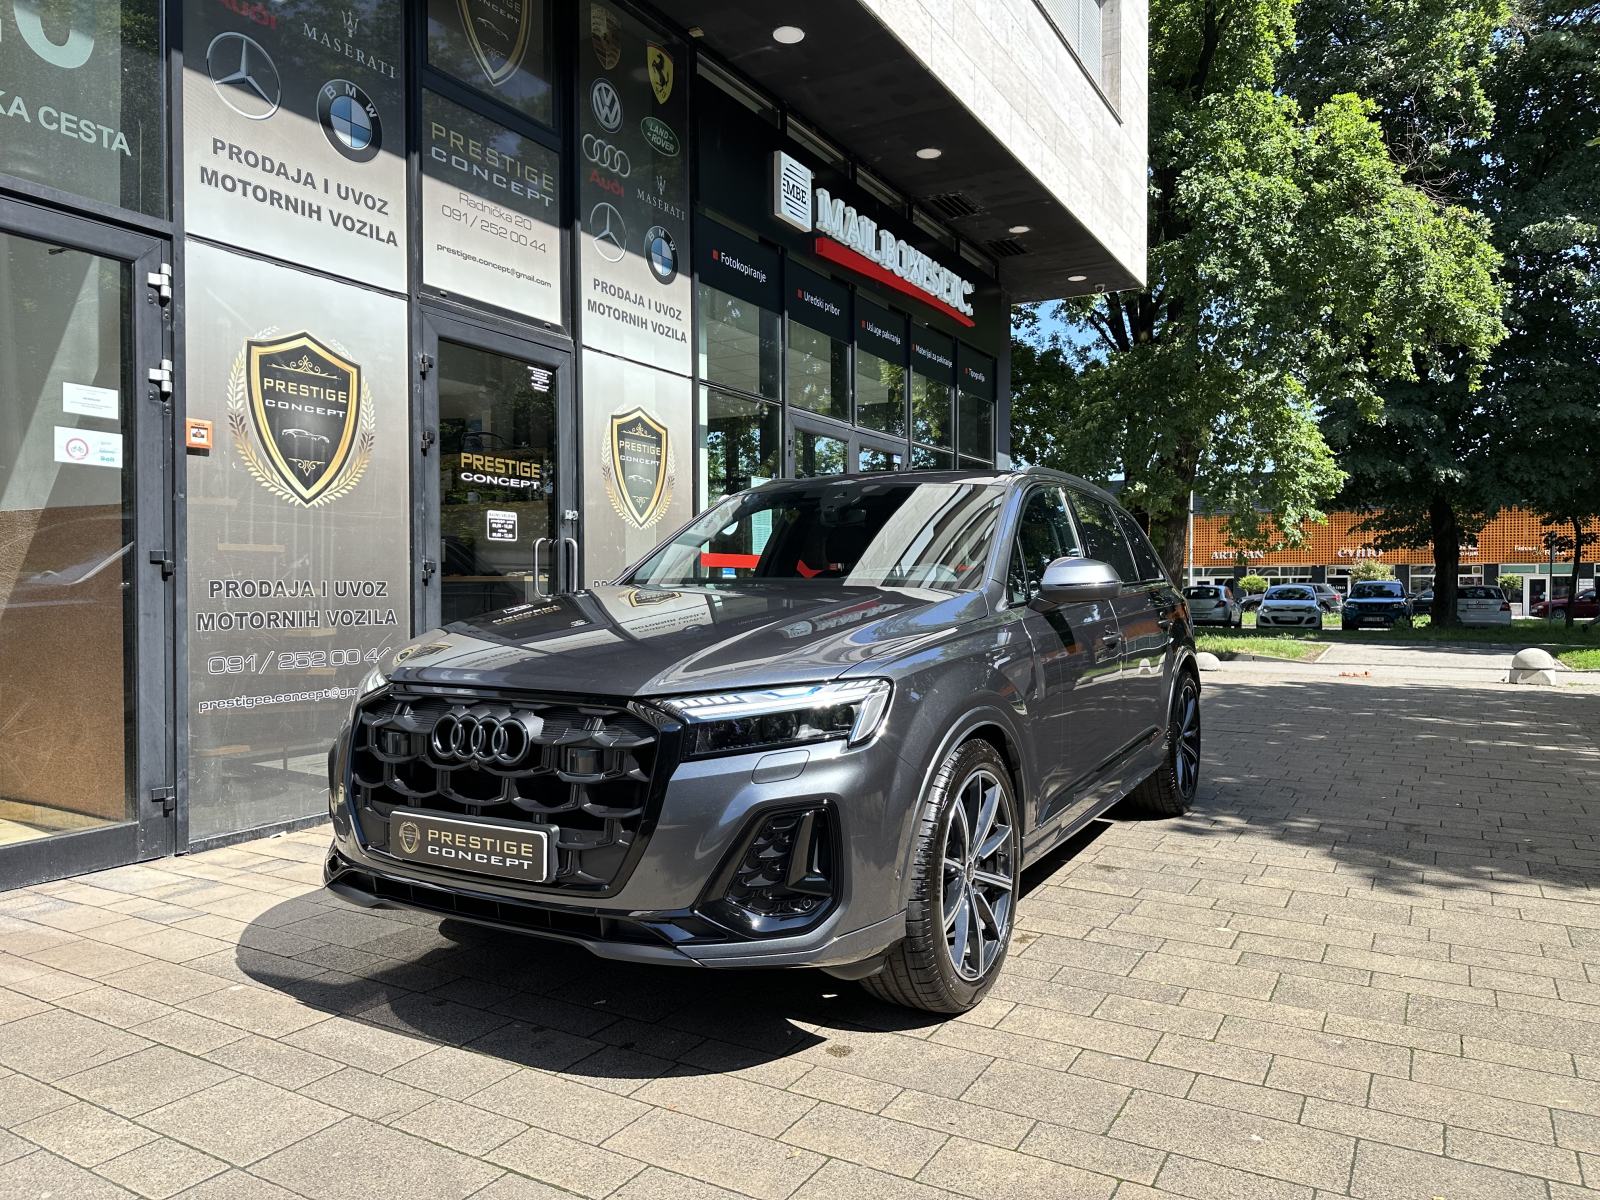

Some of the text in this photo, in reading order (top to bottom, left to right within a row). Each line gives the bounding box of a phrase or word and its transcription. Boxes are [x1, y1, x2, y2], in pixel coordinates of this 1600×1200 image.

[303, 22, 396, 79] MASERATI
[325, 84, 377, 118] BMW
[38, 106, 132, 157] CESTA
[431, 121, 554, 193] PRESTIGE
[212, 136, 389, 216] PRODAJA I UVOZ
[431, 146, 554, 207] CONCEPT
[200, 165, 398, 247] MOTORNIH VOZILA
[637, 187, 685, 221] MASERATI
[785, 180, 807, 205] MBE
[459, 191, 532, 231] Radnička 20
[510, 230, 528, 247] 00
[529, 239, 546, 253] 44
[720, 251, 767, 283] Fotokopiranje
[593, 277, 682, 321] PRODAJA I UVOZ
[803, 290, 841, 316] Uredski pribor
[587, 298, 688, 343] MOTORNIH VOZILA
[263, 377, 347, 404] PRESTIGE
[264, 398, 346, 418] CONCEPT
[619, 439, 661, 456] PRESTIGE
[619, 454, 661, 467] CONCEPT
[460, 452, 541, 479] PRESTIGE
[460, 472, 540, 489] CONCEPT
[208, 579, 388, 599] PRODAJA I UVOZ
[196, 608, 398, 632] MOTORNIH VOZILA
[330, 648, 361, 666] 00
[427, 828, 533, 857] PRESTIGE
[427, 845, 533, 870] CONCEPT
